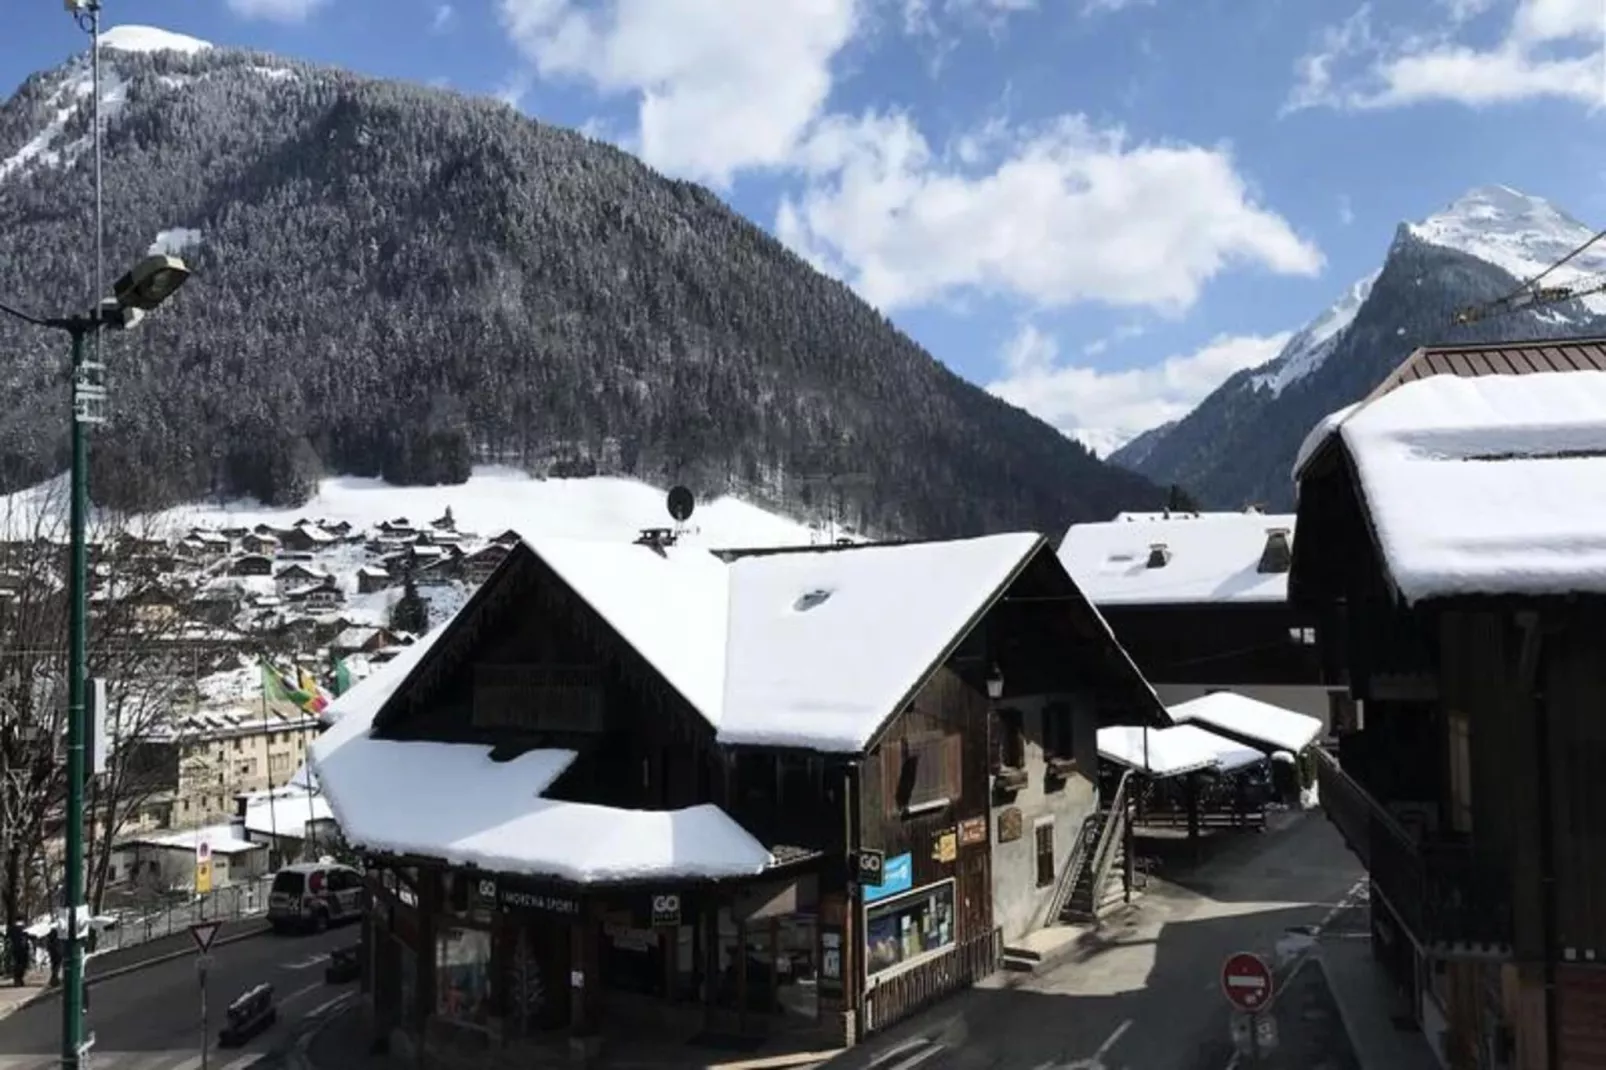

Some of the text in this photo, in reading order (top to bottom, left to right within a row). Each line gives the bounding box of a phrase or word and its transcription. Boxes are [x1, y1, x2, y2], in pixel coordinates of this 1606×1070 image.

[860, 854, 880, 871] GO
[479, 879, 496, 897] GO
[654, 895, 680, 912] GO
